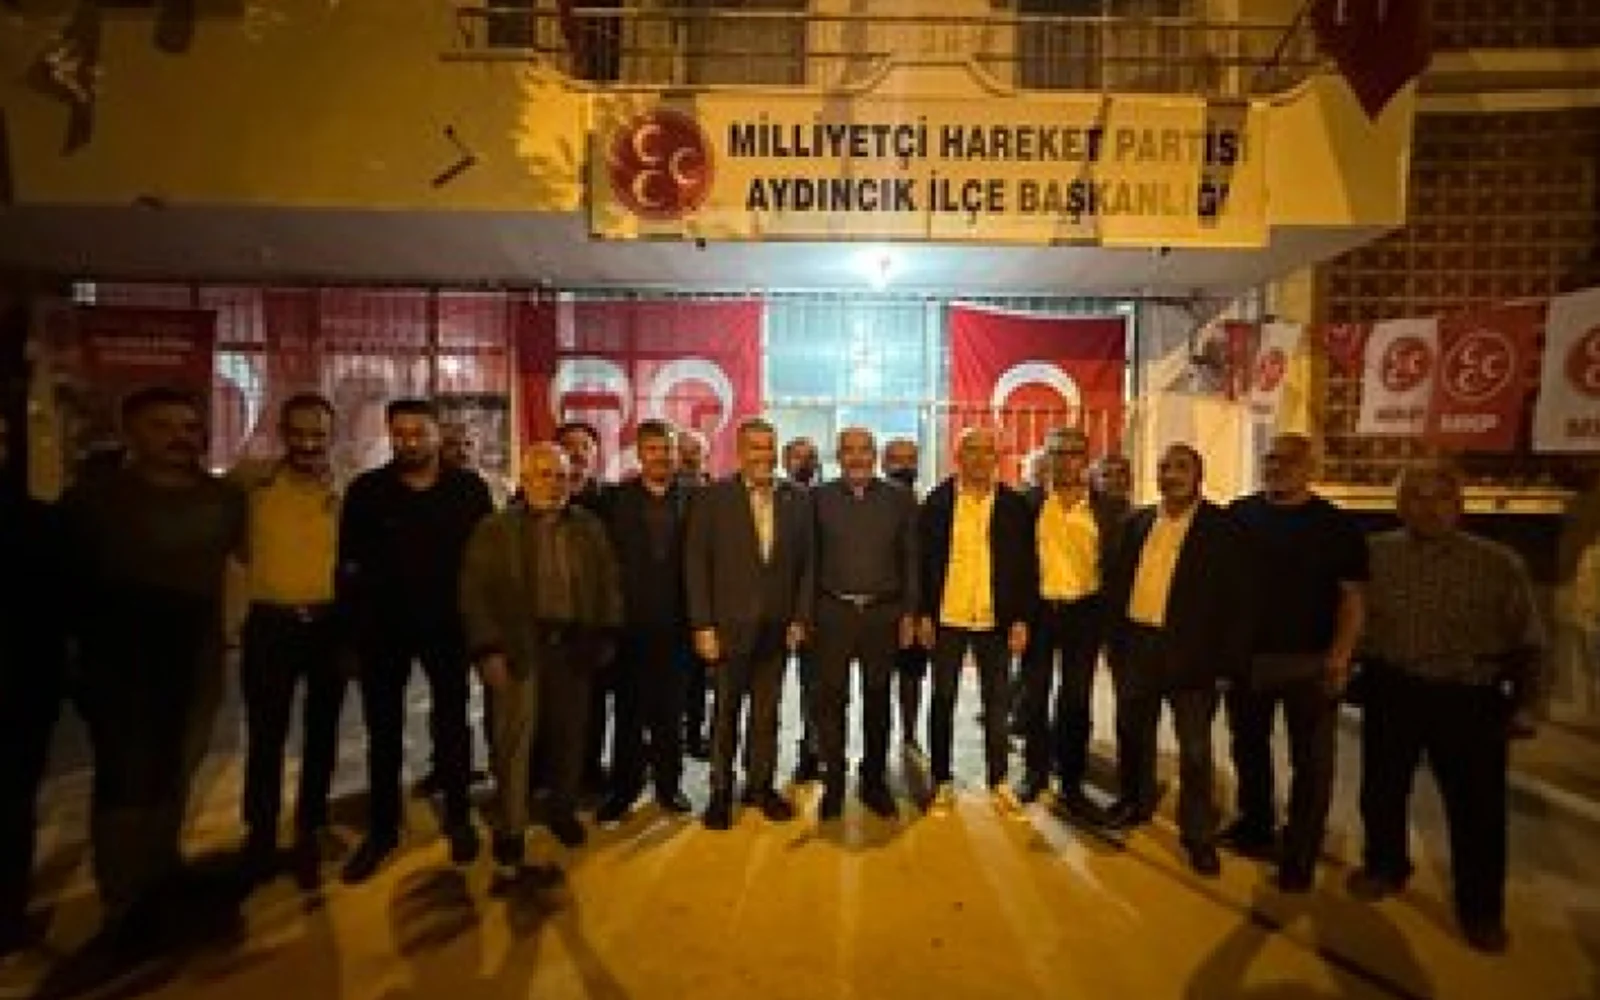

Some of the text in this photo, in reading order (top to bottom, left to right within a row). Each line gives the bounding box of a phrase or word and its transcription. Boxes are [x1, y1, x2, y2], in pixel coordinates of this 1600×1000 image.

[728, 112, 927, 170] MİLLİYETÇİ
[940, 124, 1102, 162] HAREKET
[745, 178, 918, 212] AYDINCIK
[930, 170, 1005, 224] İLÇE
